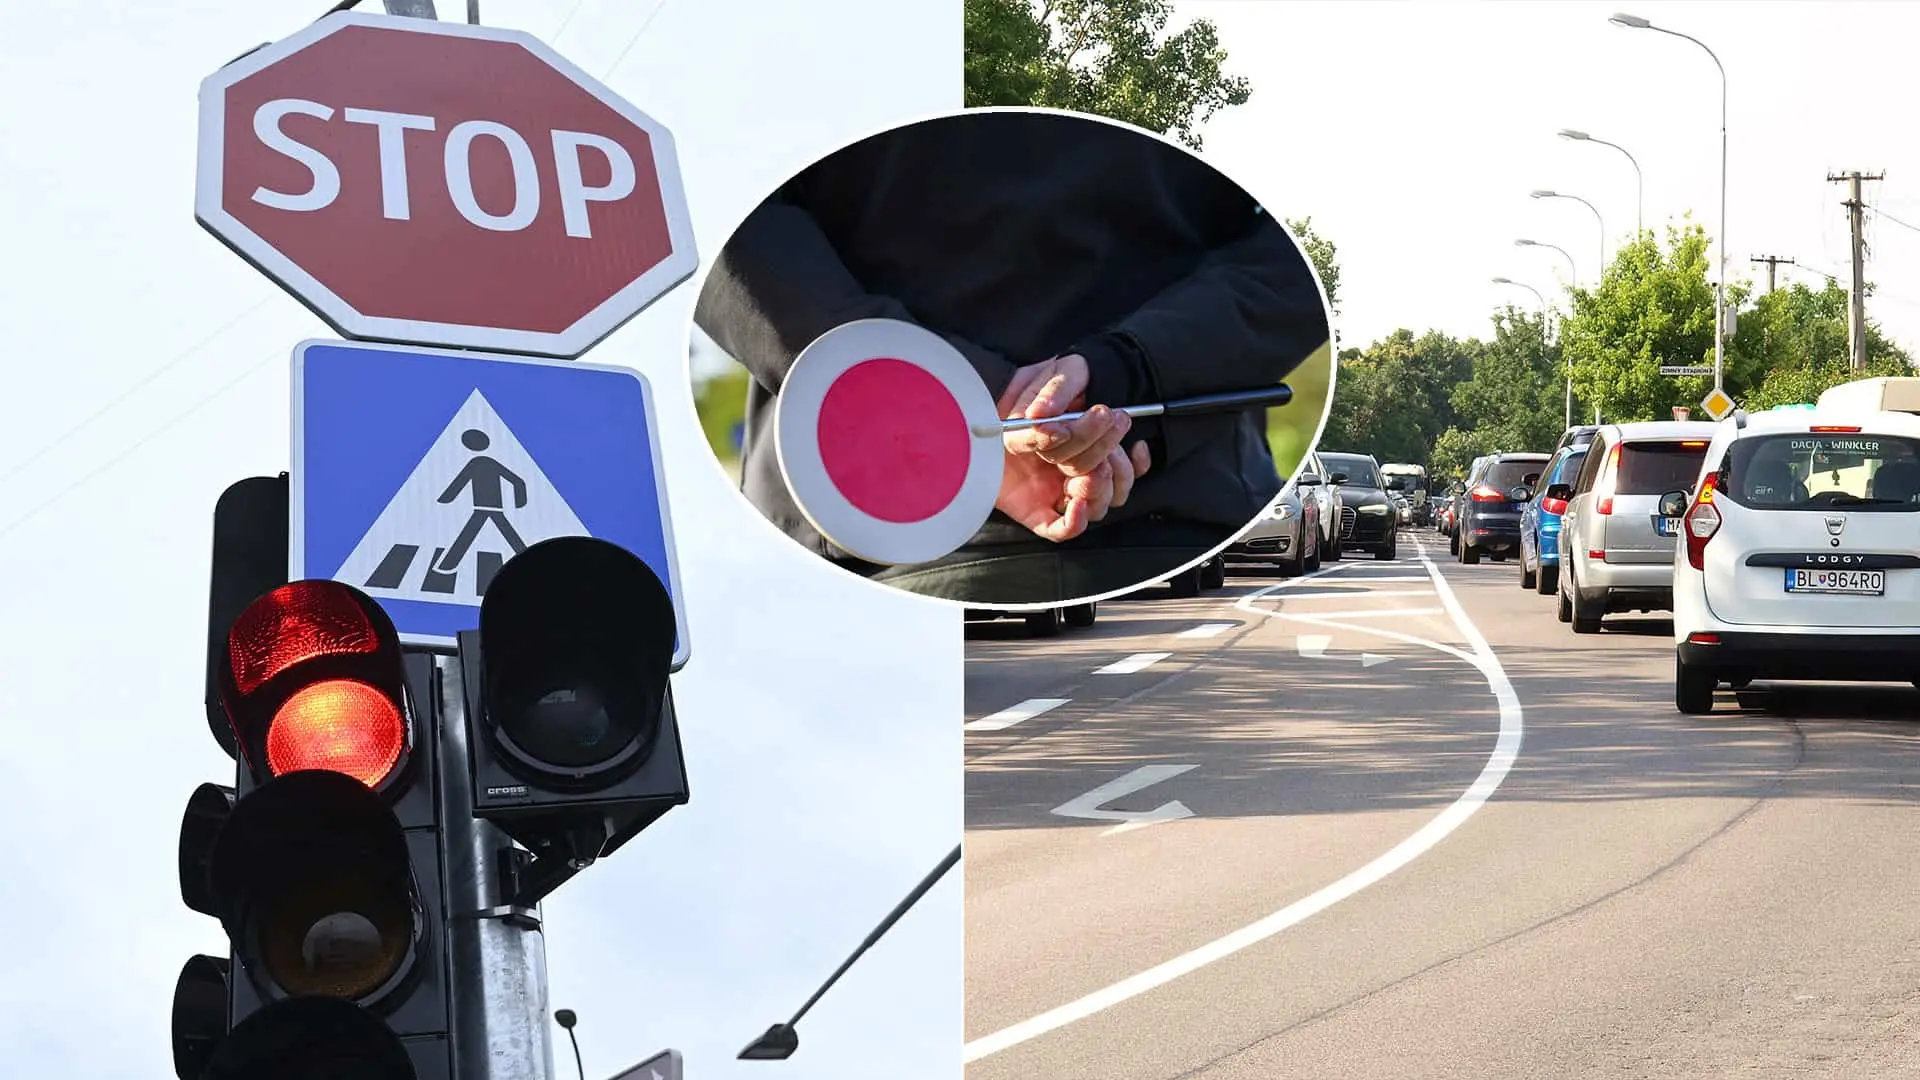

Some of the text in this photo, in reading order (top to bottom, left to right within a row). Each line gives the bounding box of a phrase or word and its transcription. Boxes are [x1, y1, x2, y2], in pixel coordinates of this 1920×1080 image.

[251, 98, 636, 239] STOP
[1791, 440, 1822, 449] DACIA
[1831, 440, 1880, 450] WINKLER
[1806, 555, 1864, 563] LODGY
[487, 786, 525, 794] cross
